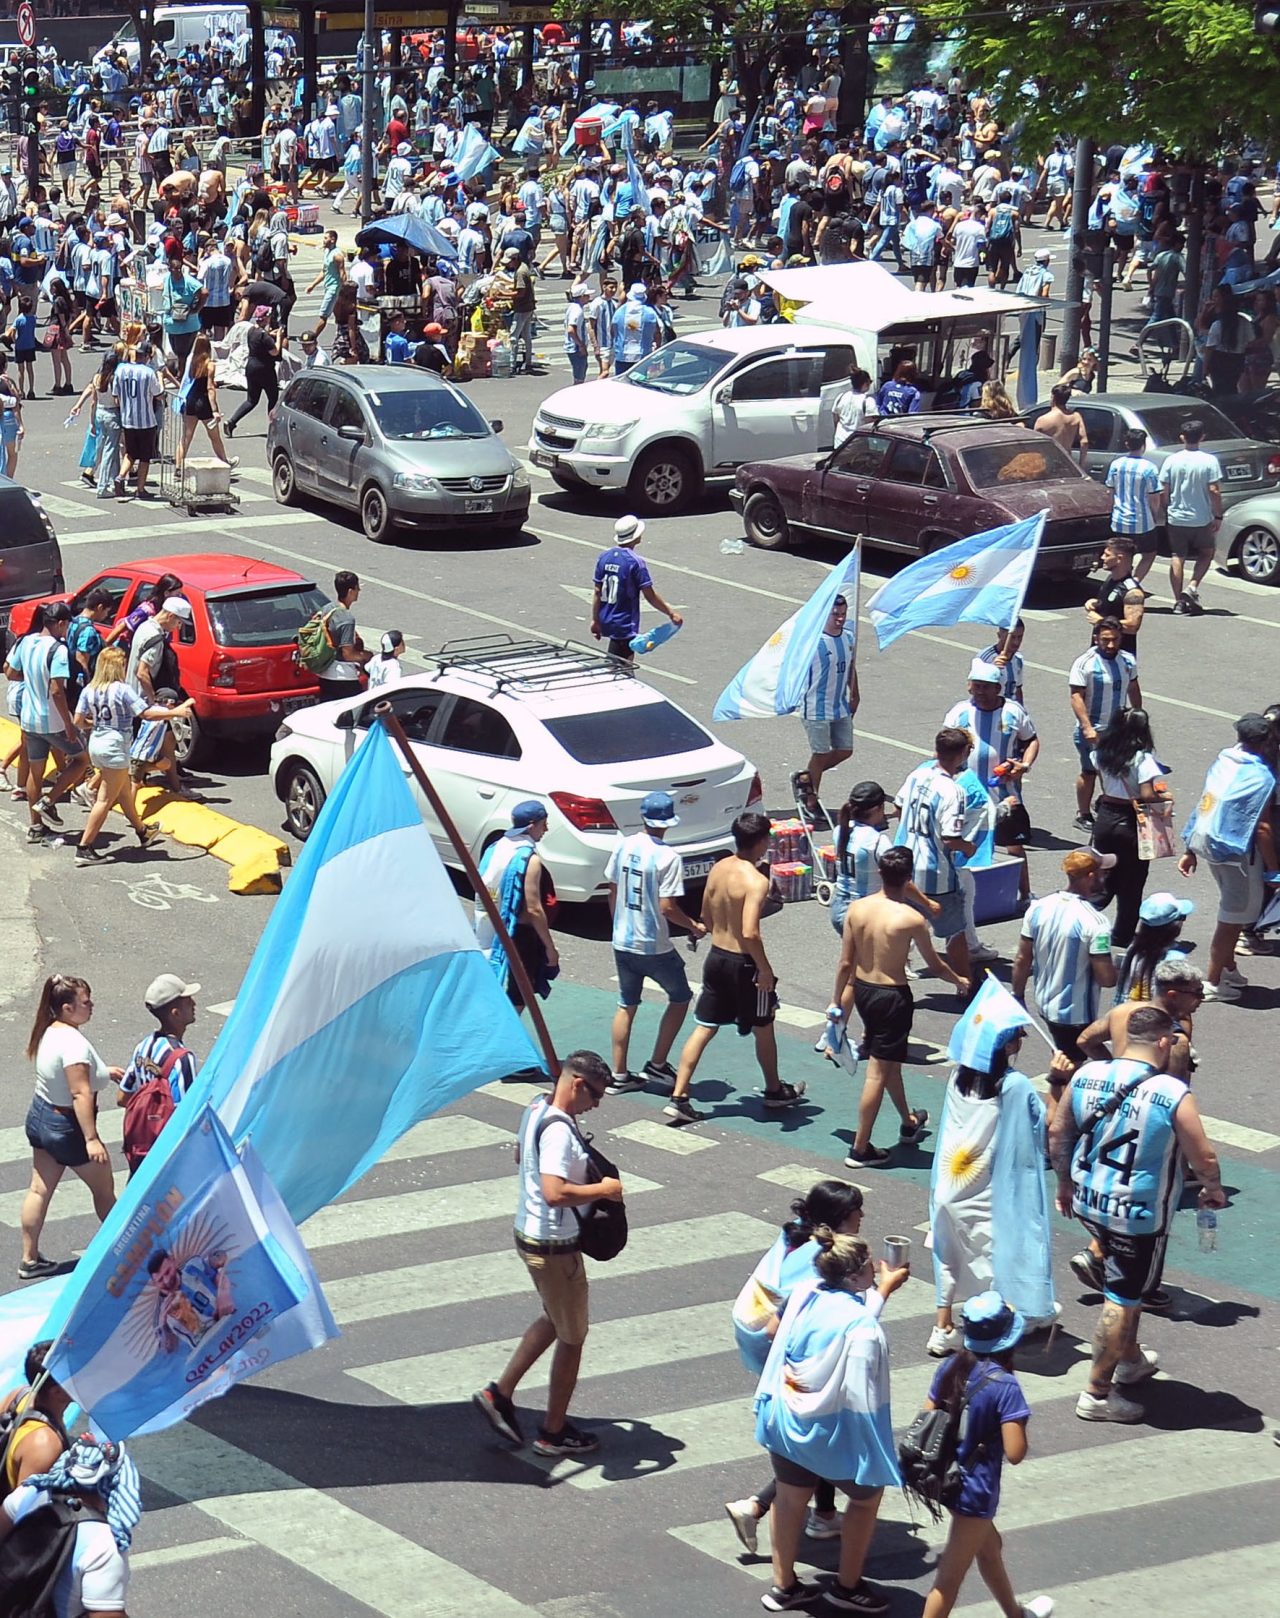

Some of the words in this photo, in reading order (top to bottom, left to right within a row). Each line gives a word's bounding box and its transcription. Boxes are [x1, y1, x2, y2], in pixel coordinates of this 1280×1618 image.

[124, 378, 138, 399] 10
[601, 574, 619, 605] 10
[836, 661, 846, 674] 10
[909, 799, 931, 838] 10
[684, 864, 701, 878] 567
[622, 866, 643, 911] 13
[1141, 1090, 1150, 1101] Y
[1078, 1128, 1140, 1186] 14
[113, 1203, 152, 1256] ARGENTINA
[192, 1290, 211, 1315] 10
